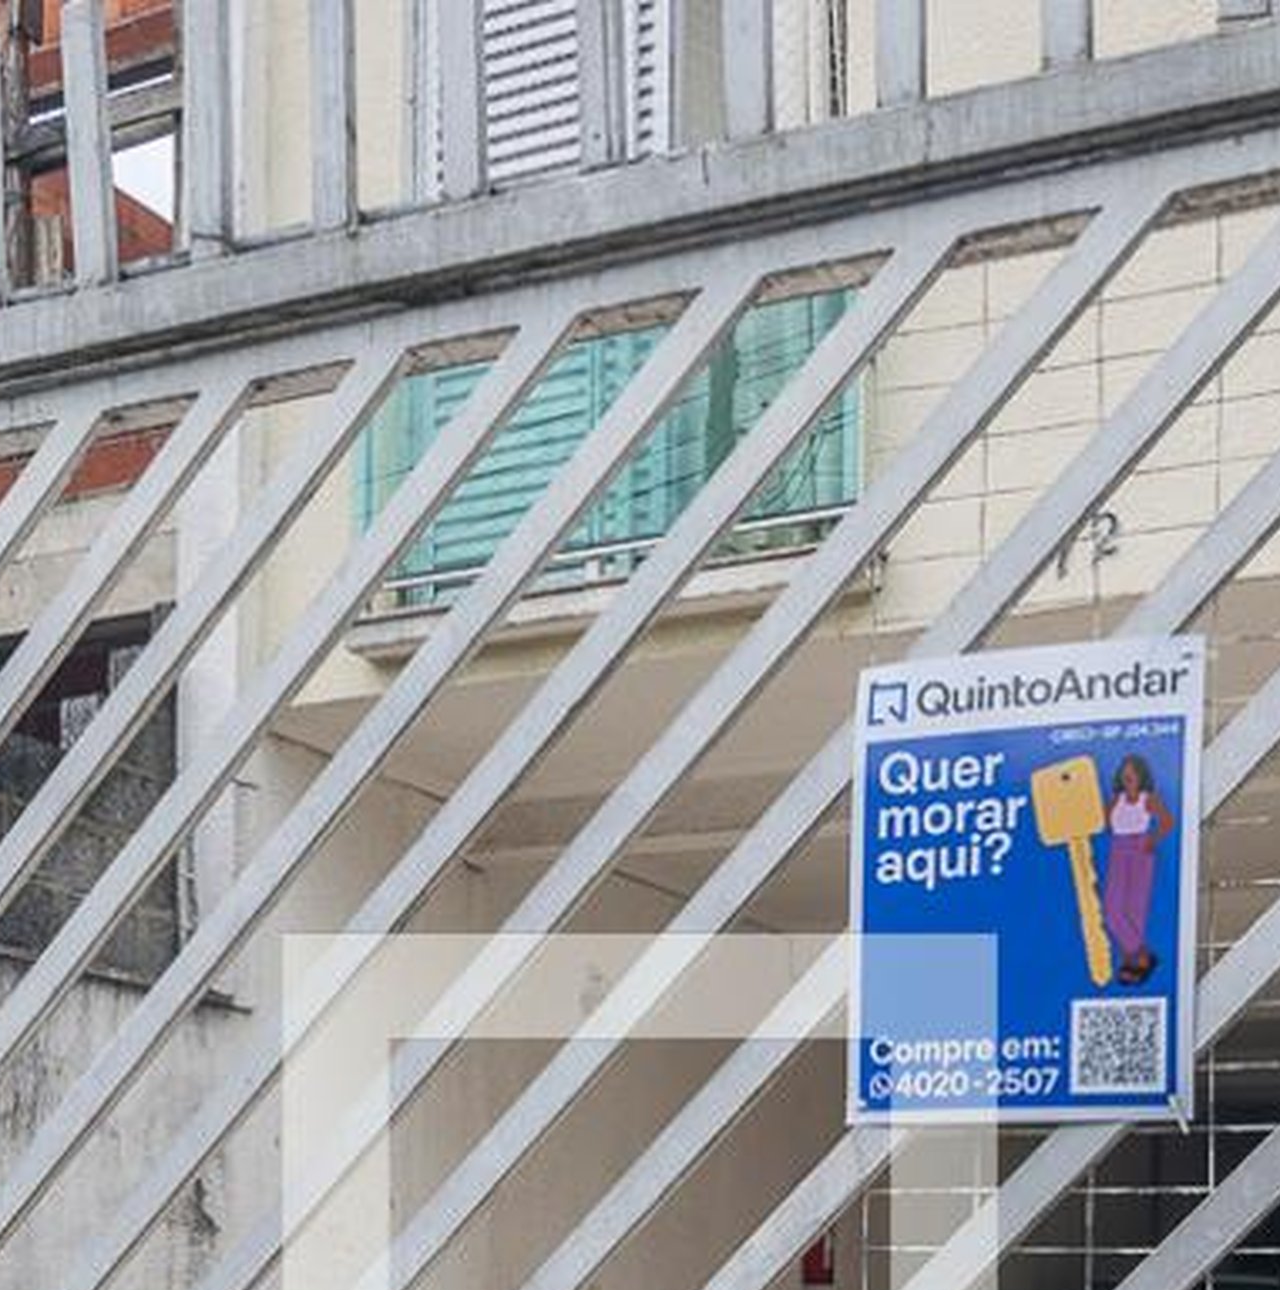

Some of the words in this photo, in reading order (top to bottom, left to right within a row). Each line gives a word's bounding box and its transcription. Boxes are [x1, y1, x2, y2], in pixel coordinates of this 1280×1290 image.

[917, 661, 1188, 717] QuintoAndar
[879, 751, 1004, 795] Quer
[878, 796, 1028, 839] morar
[876, 832, 1012, 891] aqui?
[870, 1036, 997, 1067] Compre
[1002, 1036, 1061, 1061] em:
[896, 1068, 1060, 1098] 4020-2507
